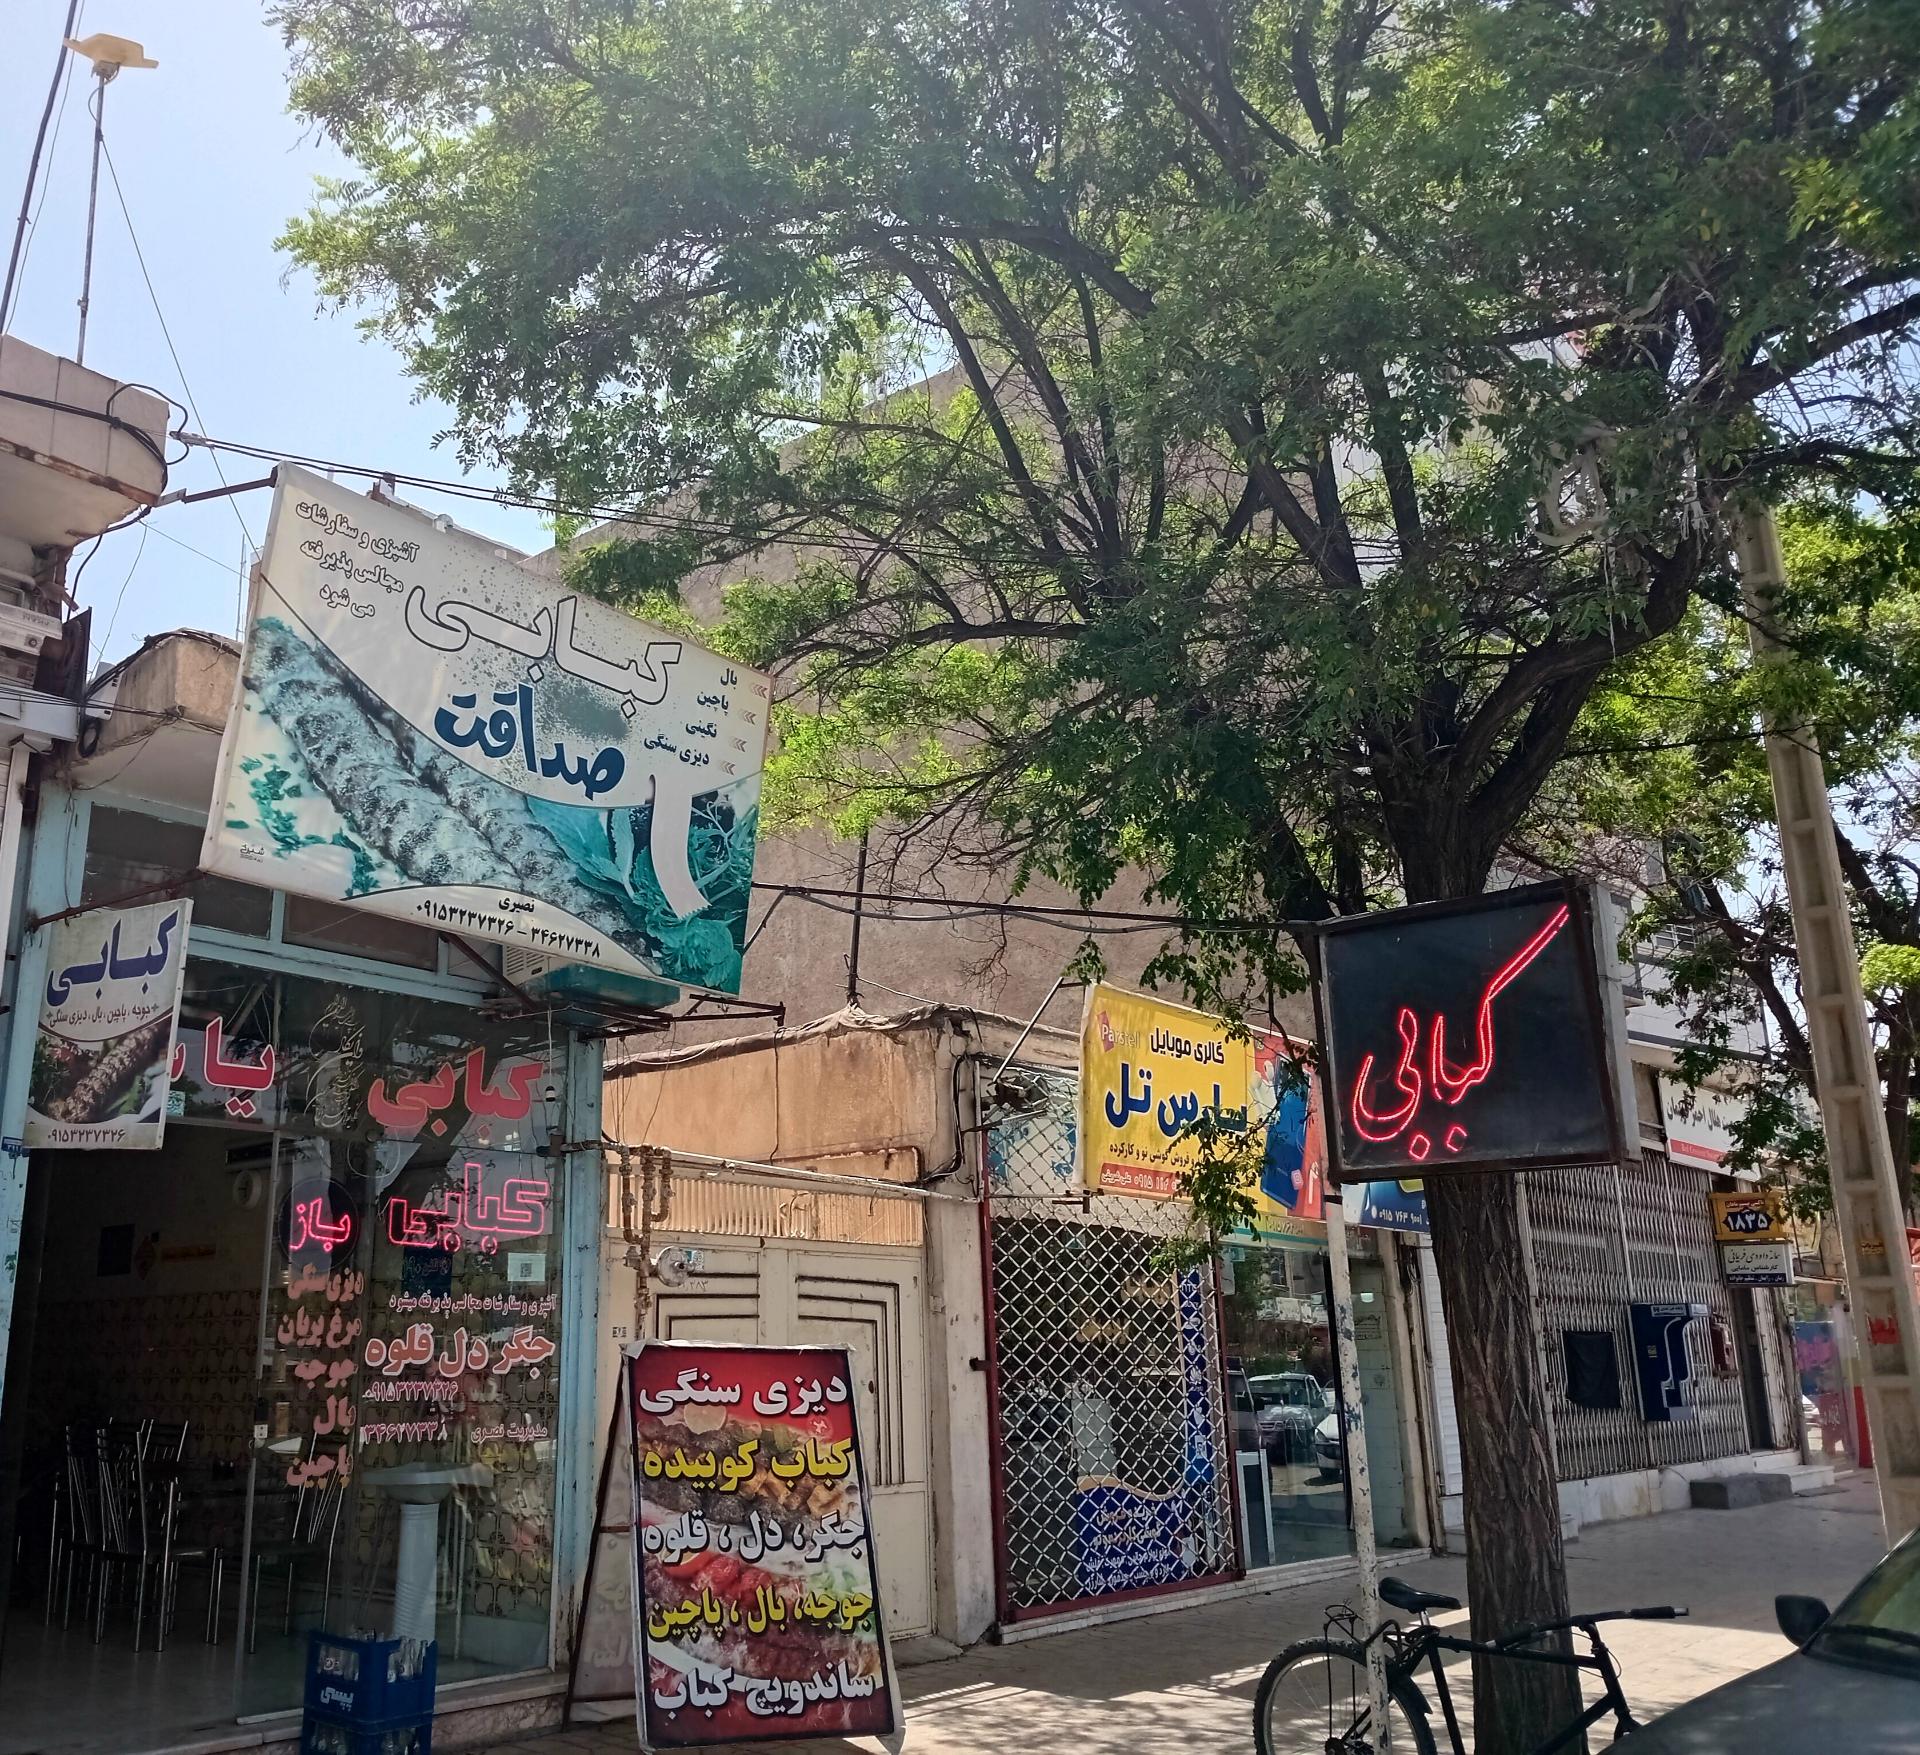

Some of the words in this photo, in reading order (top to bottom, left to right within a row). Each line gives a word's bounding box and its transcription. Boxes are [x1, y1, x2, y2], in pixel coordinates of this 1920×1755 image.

[296, 502, 358, 539] سفارشات
[358, 532, 370, 549] و
[300, 540, 353, 579] پذیرفته
[370, 538, 420, 563] آشپزی
[320, 584, 350, 608] شود
[354, 565, 404, 593] مجالس
[351, 603, 375, 618] می
[405, 584, 682, 718] کبابی
[720, 667, 738, 690] بال
[697, 691, 729, 716] پاچین
[434, 682, 626, 801] صداقت
[643, 734, 677, 753] سنگی
[685, 719, 717, 738] نگینی
[679, 748, 709, 767] دیزی
[498, 897, 535, 913] نصیری
[46, 908, 179, 1007] کبابی
[531, 926, 601, 959] ۳۴۶۲۷۳۳۸
[1150, 1027, 1192, 1059] موبایل
[1353, 904, 1570, 1160] کبابی
[1194, 1041, 1225, 1065] گالری
[368, 1046, 545, 1137] کبابی
[289, 1197, 351, 1253] باز
[388, 1162, 549, 1255] کبابی
[1727, 1213, 1768, 1231] ۱۸۳۵
[364, 1322, 434, 1376] قلوه
[439, 1326, 489, 1377] دل
[492, 1324, 556, 1379] جگر
[640, 1367, 740, 1414] سنگی
[753, 1373, 848, 1416] دیزی
[644, 1440, 759, 1491] کوبیده
[771, 1436, 852, 1490] کباب
[644, 1509, 709, 1563] قلوه
[648, 1588, 722, 1640] پاچین
[320, 1686, 354, 1712] پپسی
[655, 1665, 735, 1719] کباب
[746, 1660, 876, 1716] ساندویچ
